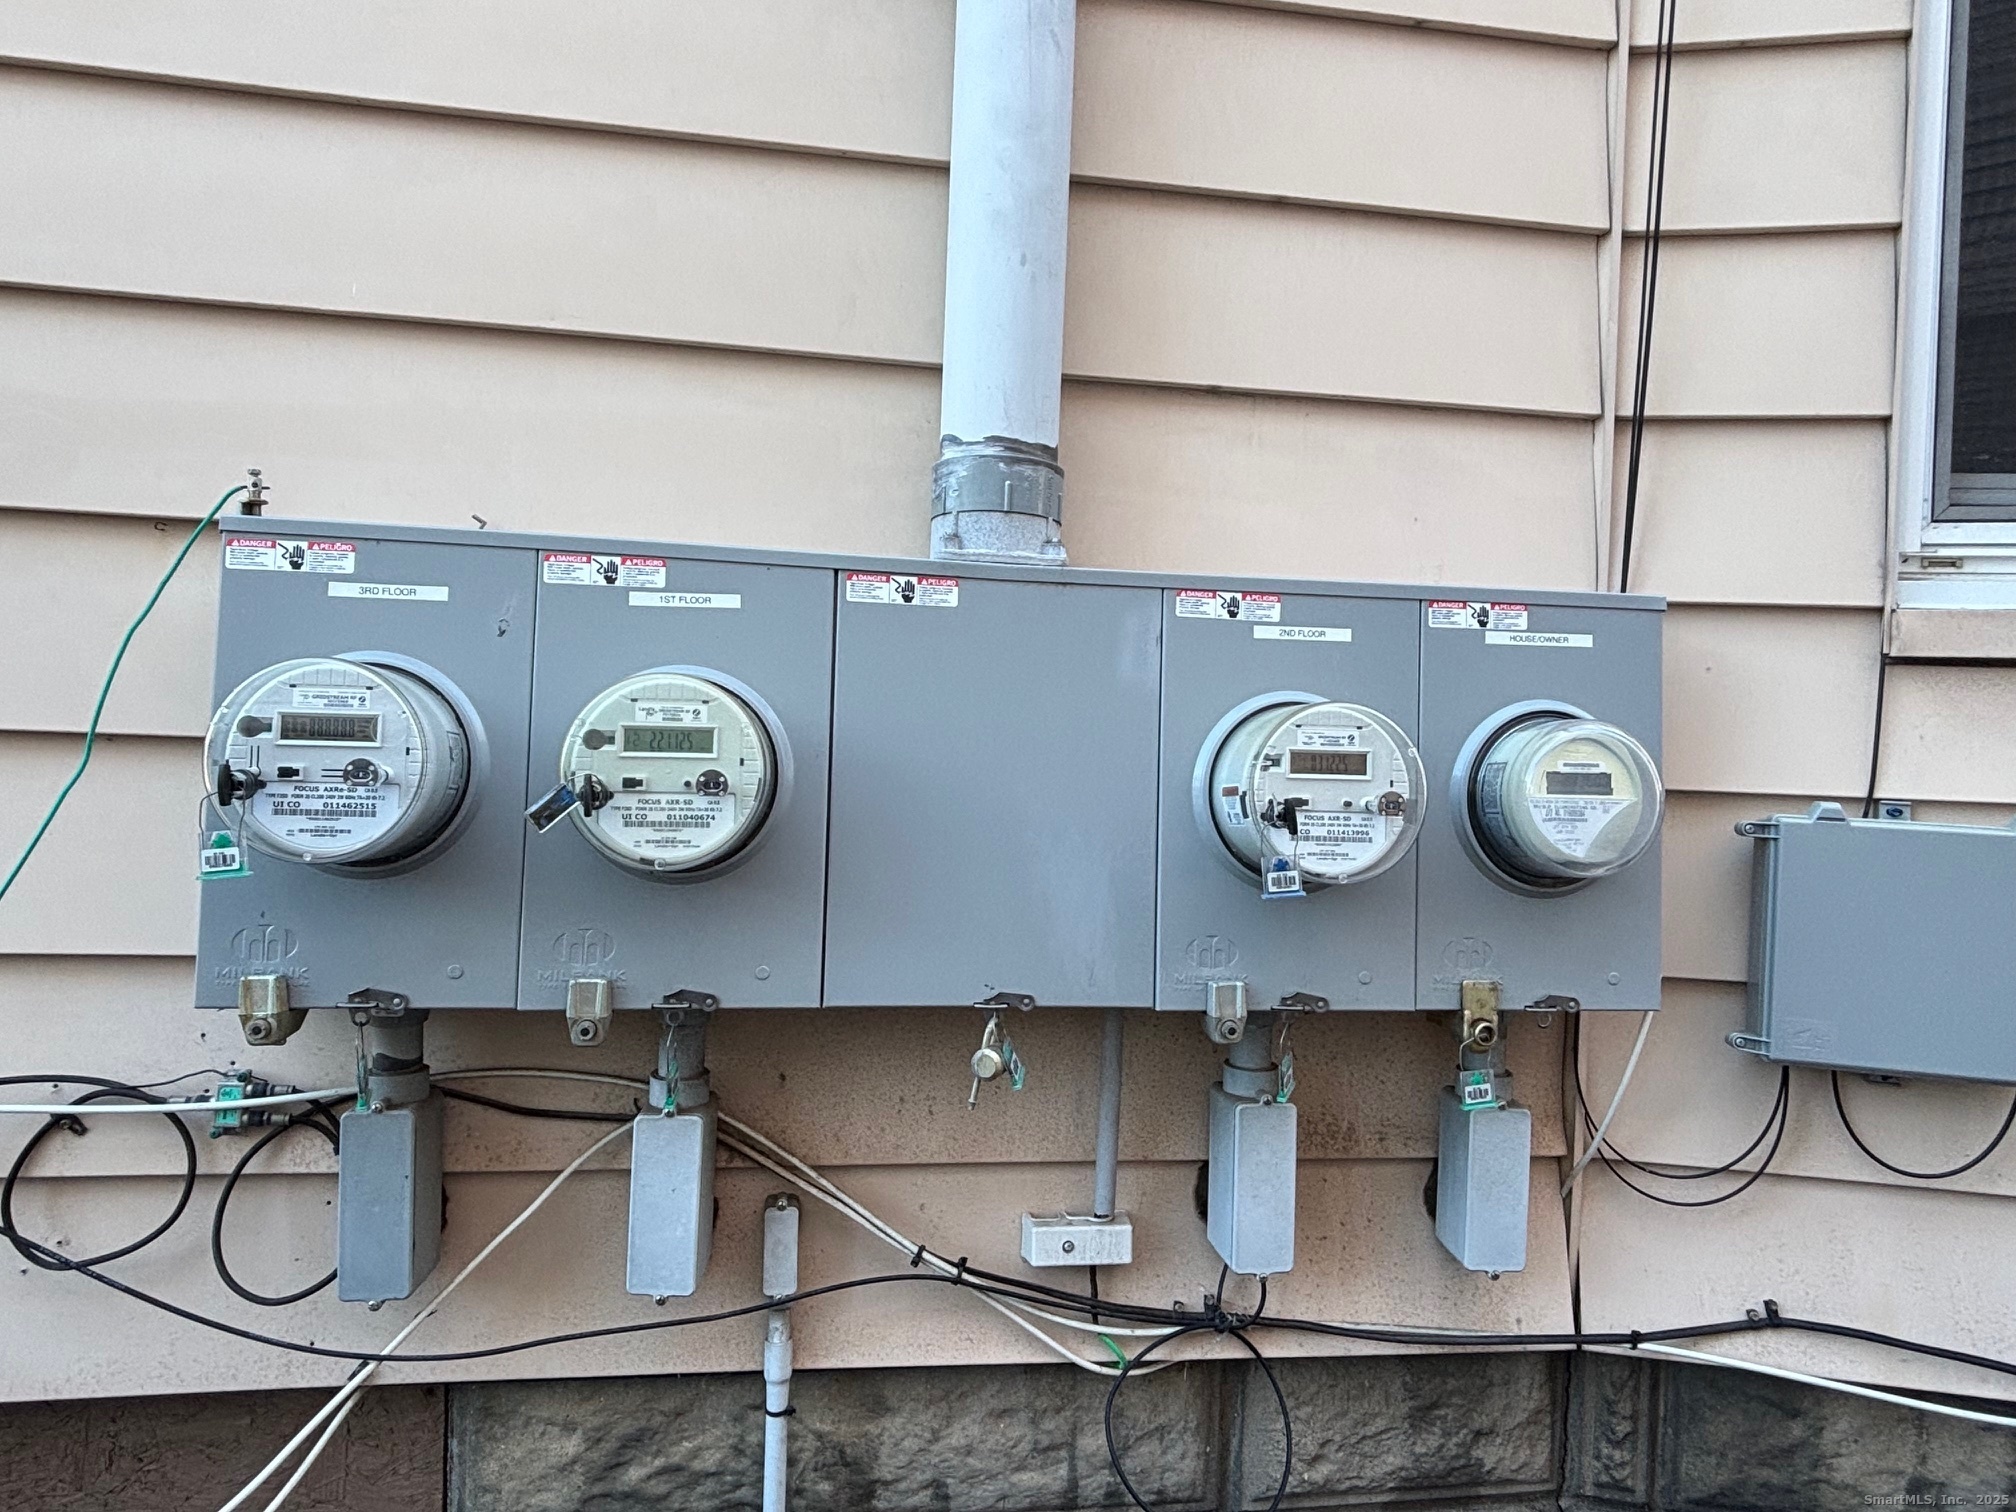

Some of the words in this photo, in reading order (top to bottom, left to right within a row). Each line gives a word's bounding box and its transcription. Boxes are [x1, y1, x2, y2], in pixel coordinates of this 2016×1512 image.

[240, 539, 272, 547] DANGER
[320, 543, 353, 551] PELIGRO
[632, 559, 663, 567] PELIGRO
[359, 586, 380, 595] 3RD
[382, 587, 417, 596] FLOOR
[659, 595, 676, 604] 1ST
[679, 596, 712, 604] FLOOR
[1279, 629, 1296, 637] 2ND
[1298, 630, 1326, 638] FLOOR
[1509, 635, 1569, 644] HOUSE/OWNER
[323, 802, 376, 810] 011462515
